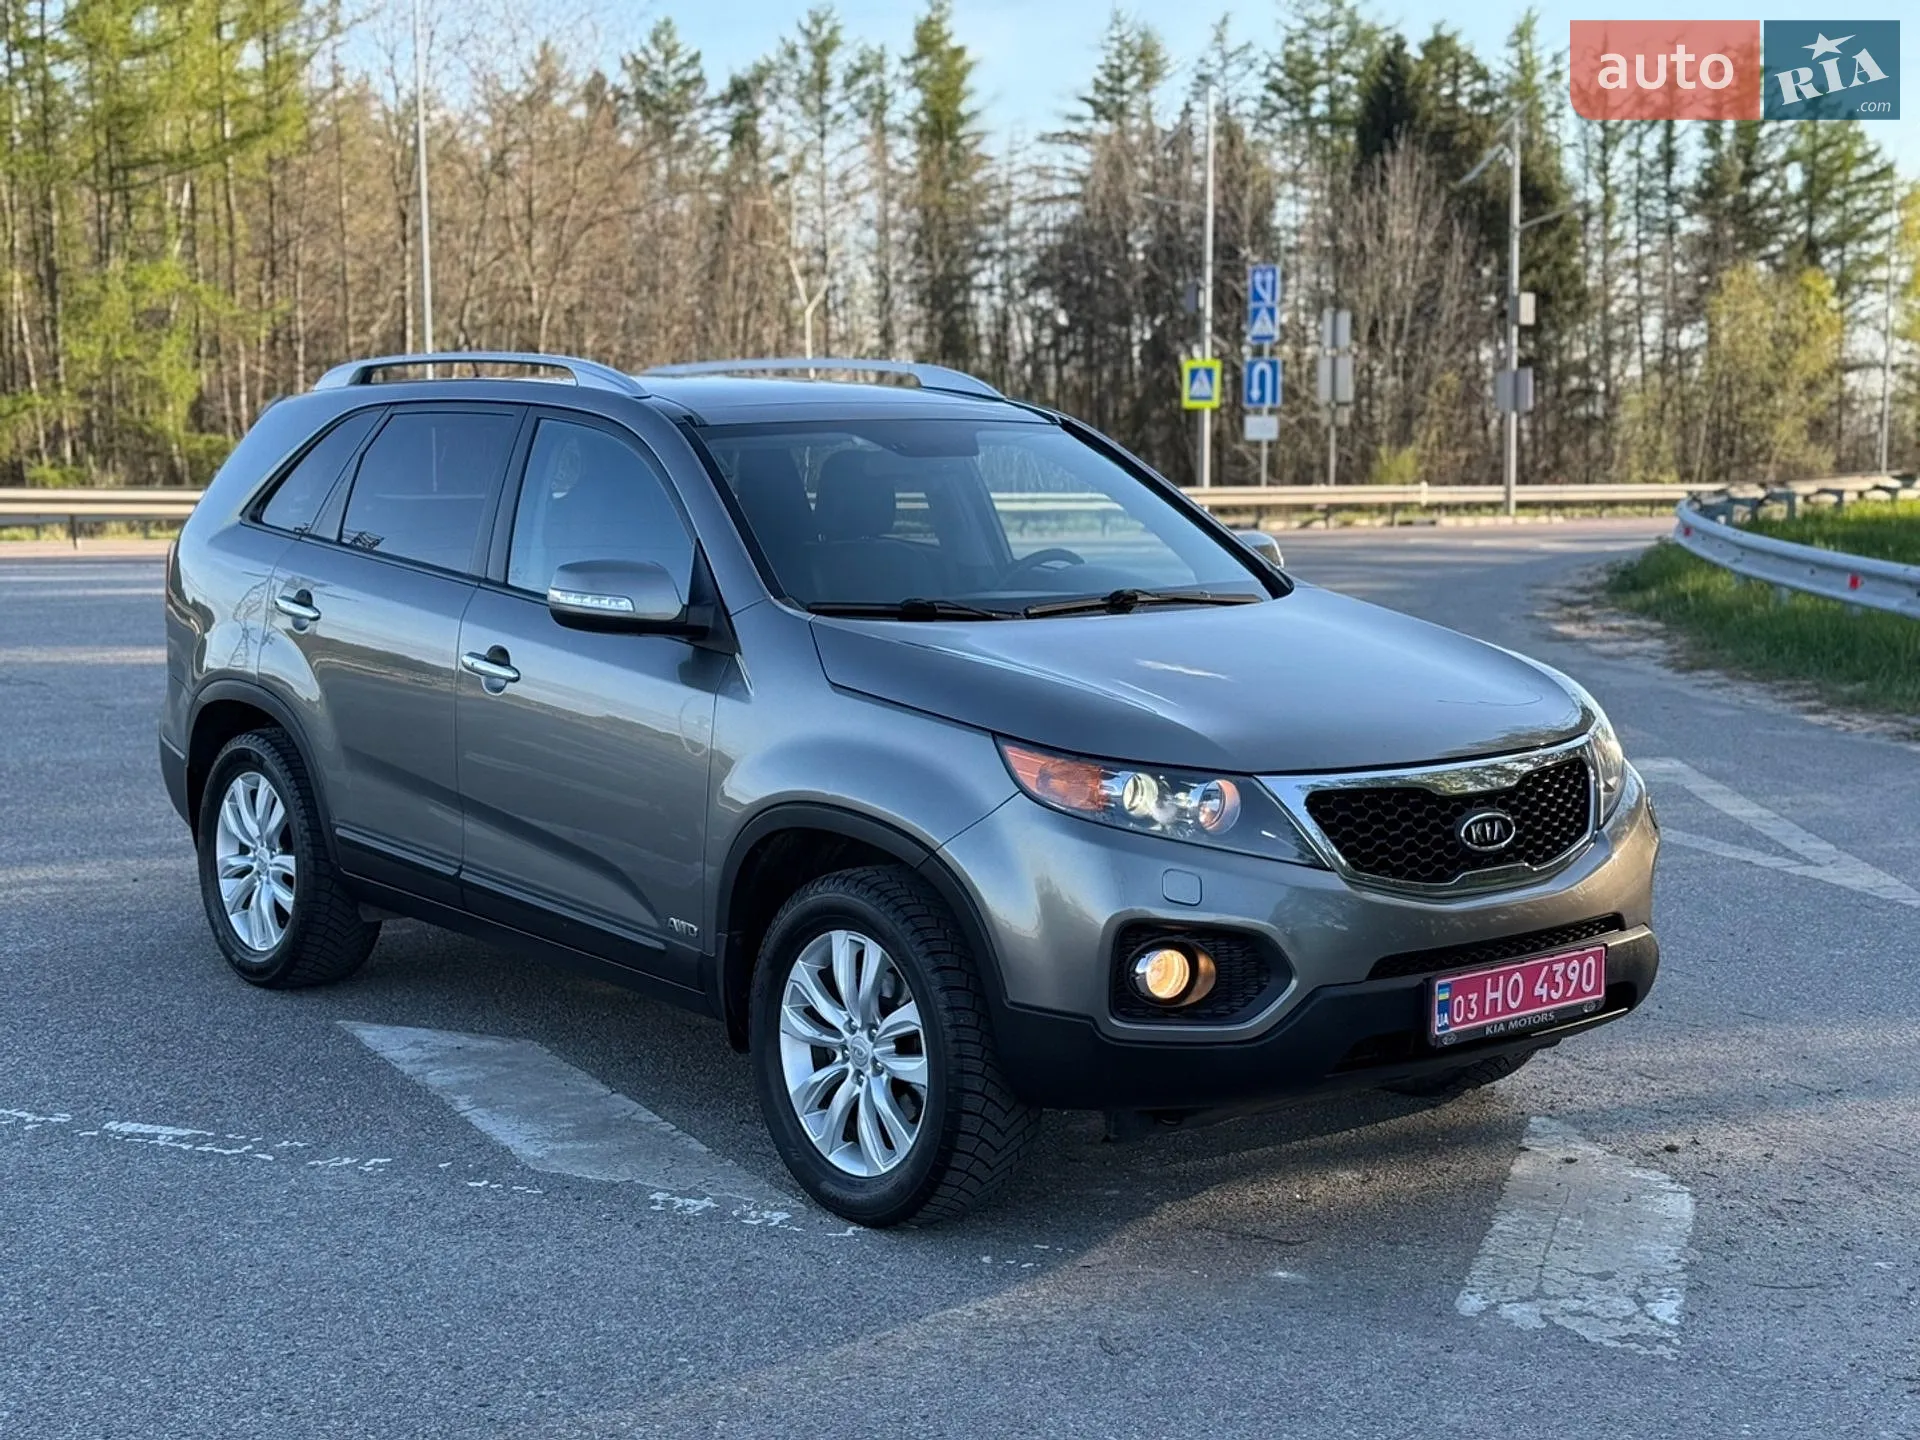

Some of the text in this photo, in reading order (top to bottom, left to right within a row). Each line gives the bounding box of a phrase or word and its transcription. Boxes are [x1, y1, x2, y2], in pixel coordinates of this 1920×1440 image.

[1470, 820, 1506, 844] KIA
[667, 917, 699, 938] AWD
[1453, 956, 1596, 1023] 03 HO 4390
[1437, 1013, 1449, 1027] UA
[1485, 1012, 1555, 1035] KIA MOTORS
